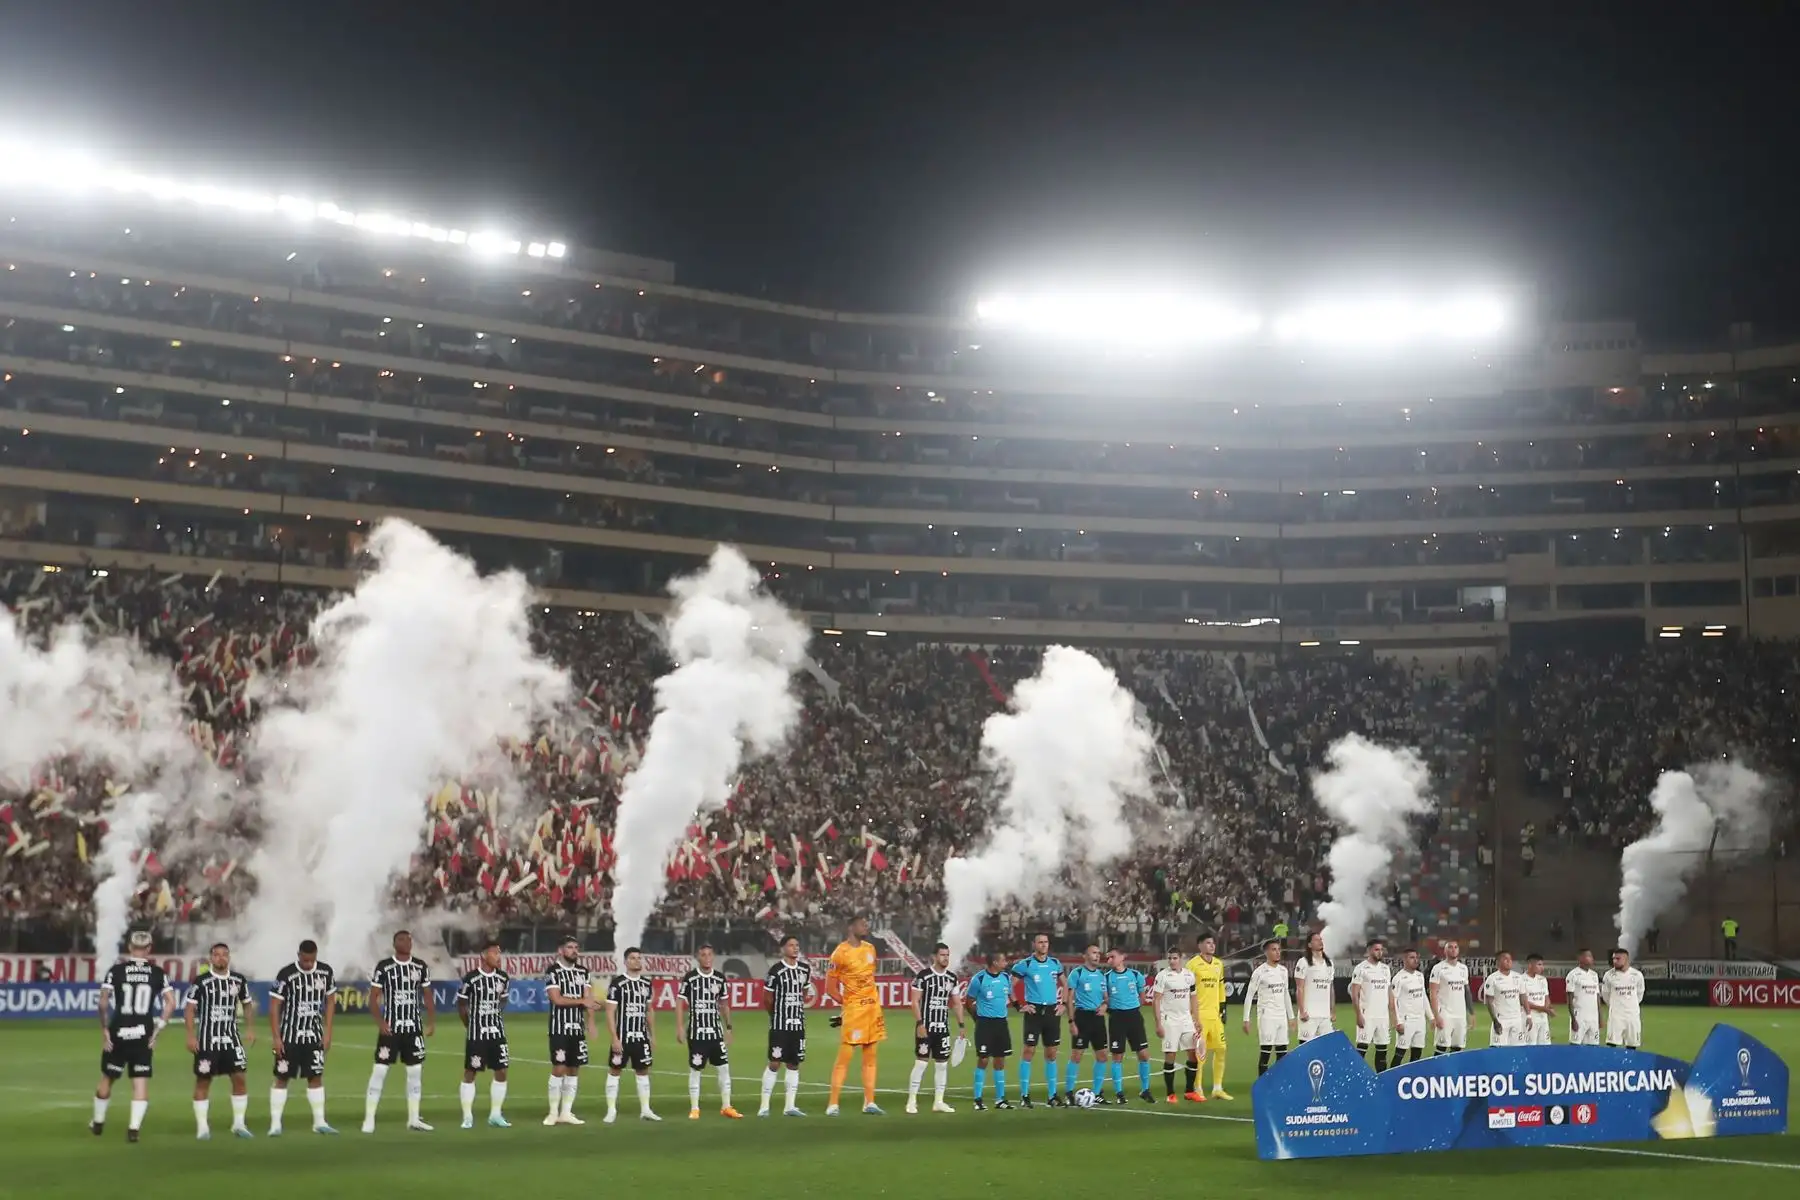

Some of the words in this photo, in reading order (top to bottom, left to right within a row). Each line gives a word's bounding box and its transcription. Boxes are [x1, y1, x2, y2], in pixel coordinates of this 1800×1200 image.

[645, 957, 692, 973] SANGRES
[121, 983, 152, 1015] 10
[1738, 984, 1769, 1004] MG
[1398, 1074, 1519, 1100] CONMEBOL
[1525, 1069, 1676, 1097] SUDAMERICANA
[1722, 1095, 1771, 1107] SUDAMERICANA
[1285, 1113, 1349, 1126] SUDAMERICANA
[1288, 1129, 1310, 1138] GRAN
[1313, 1127, 1359, 1137] CONQUISTA
